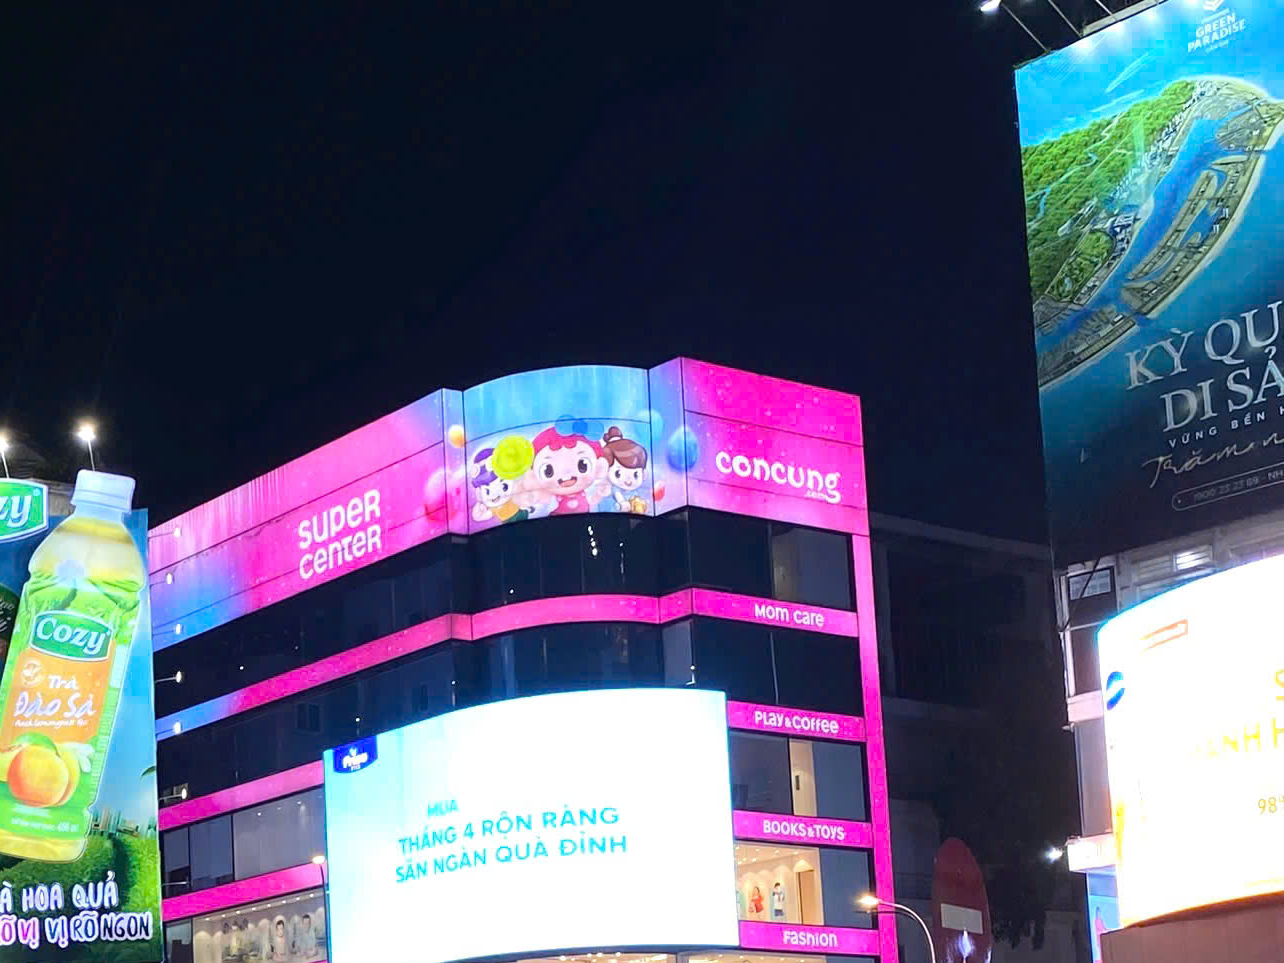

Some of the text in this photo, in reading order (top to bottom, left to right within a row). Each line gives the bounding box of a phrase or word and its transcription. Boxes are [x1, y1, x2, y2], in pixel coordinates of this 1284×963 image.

[1188, 19, 1246, 53] PARADISE
[1196, 12, 1236, 38] GREEN
[1125, 327, 1194, 390] KỲ
[1160, 378, 1218, 432] DI
[716, 451, 841, 504] concung
[36, 617, 106, 655] Cozy
[398, 826, 457, 855] THÁNG
[463, 823, 475, 840] 4
[495, 835, 549, 863] QUÀ
[21, 881, 64, 913] HOA
[72, 870, 119, 910] QUẢ
[17, 916, 40, 949] VỊ
[44, 915, 69, 949] VỊ
[70, 910, 99, 942] RÕ
[100, 911, 154, 941] NGON
